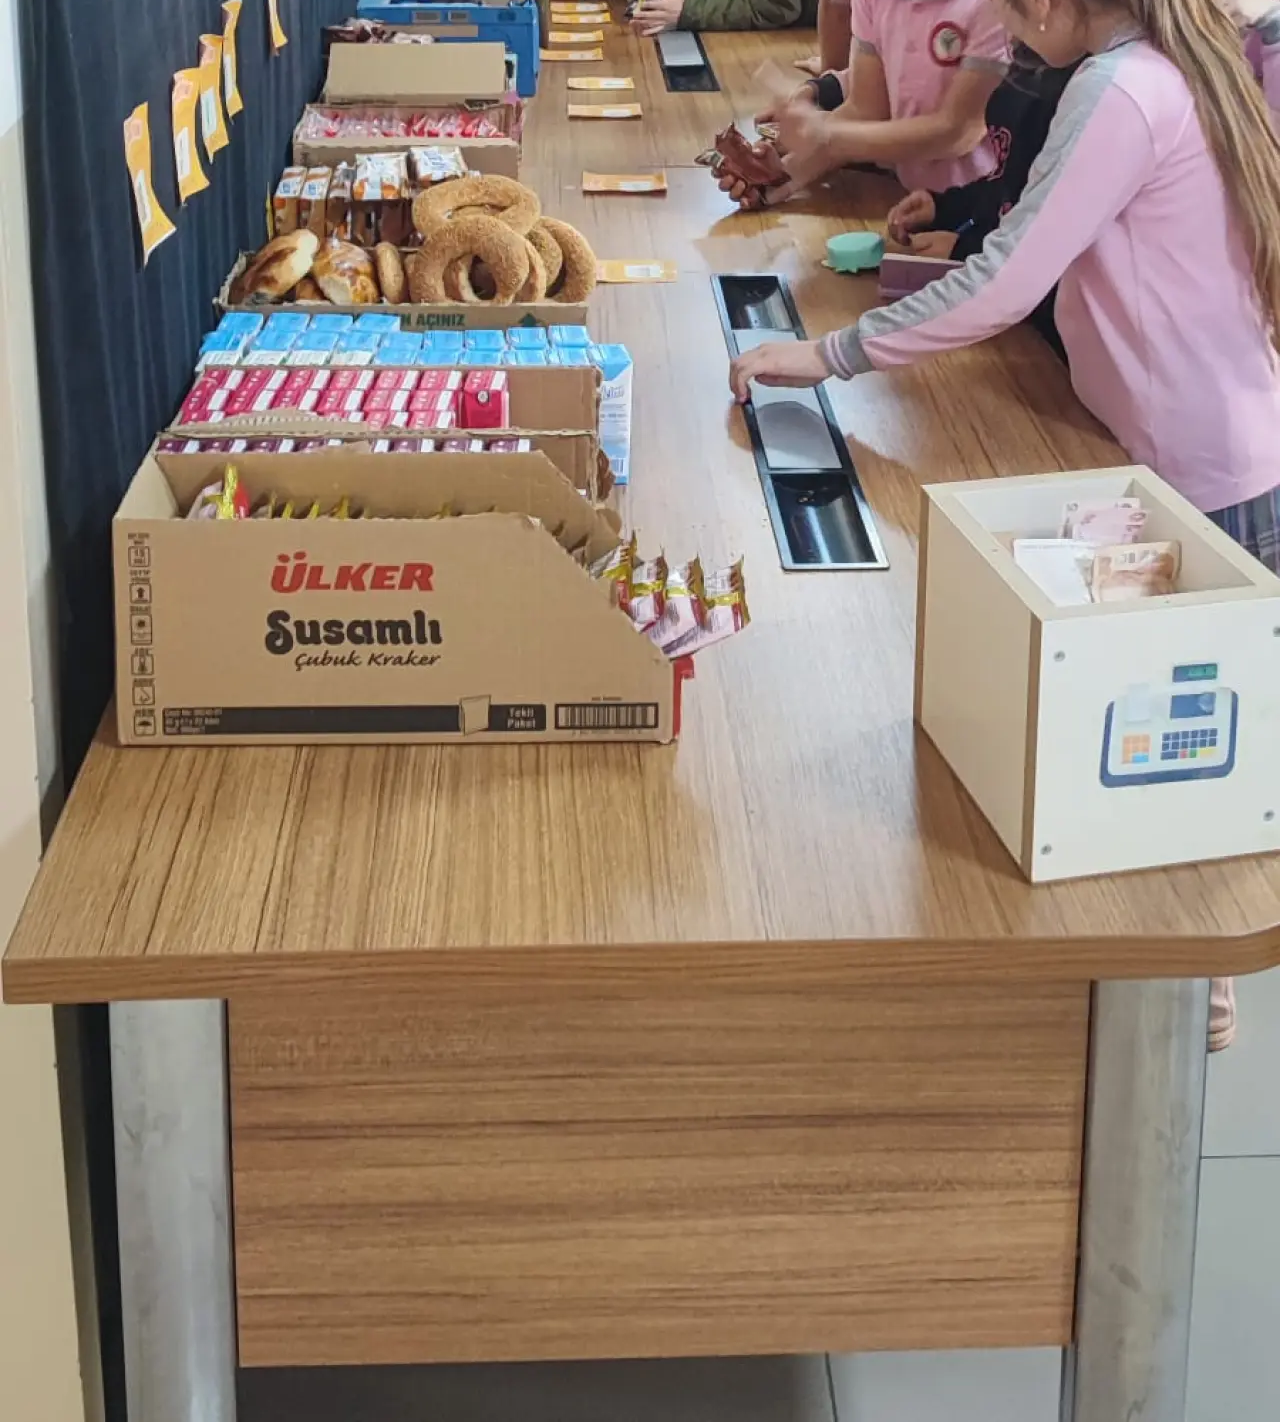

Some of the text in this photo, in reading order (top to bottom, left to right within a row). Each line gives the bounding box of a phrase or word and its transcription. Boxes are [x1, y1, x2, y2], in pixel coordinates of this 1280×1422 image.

[416, 313, 465, 330] AÇINIZ
[270, 551, 435, 594] ÜLKER
[265, 609, 443, 655] Susamlı
[294, 649, 442, 672] Çubuk Kraker
[509, 706, 534, 718] Tekli
[507, 718, 536, 729] Paket
